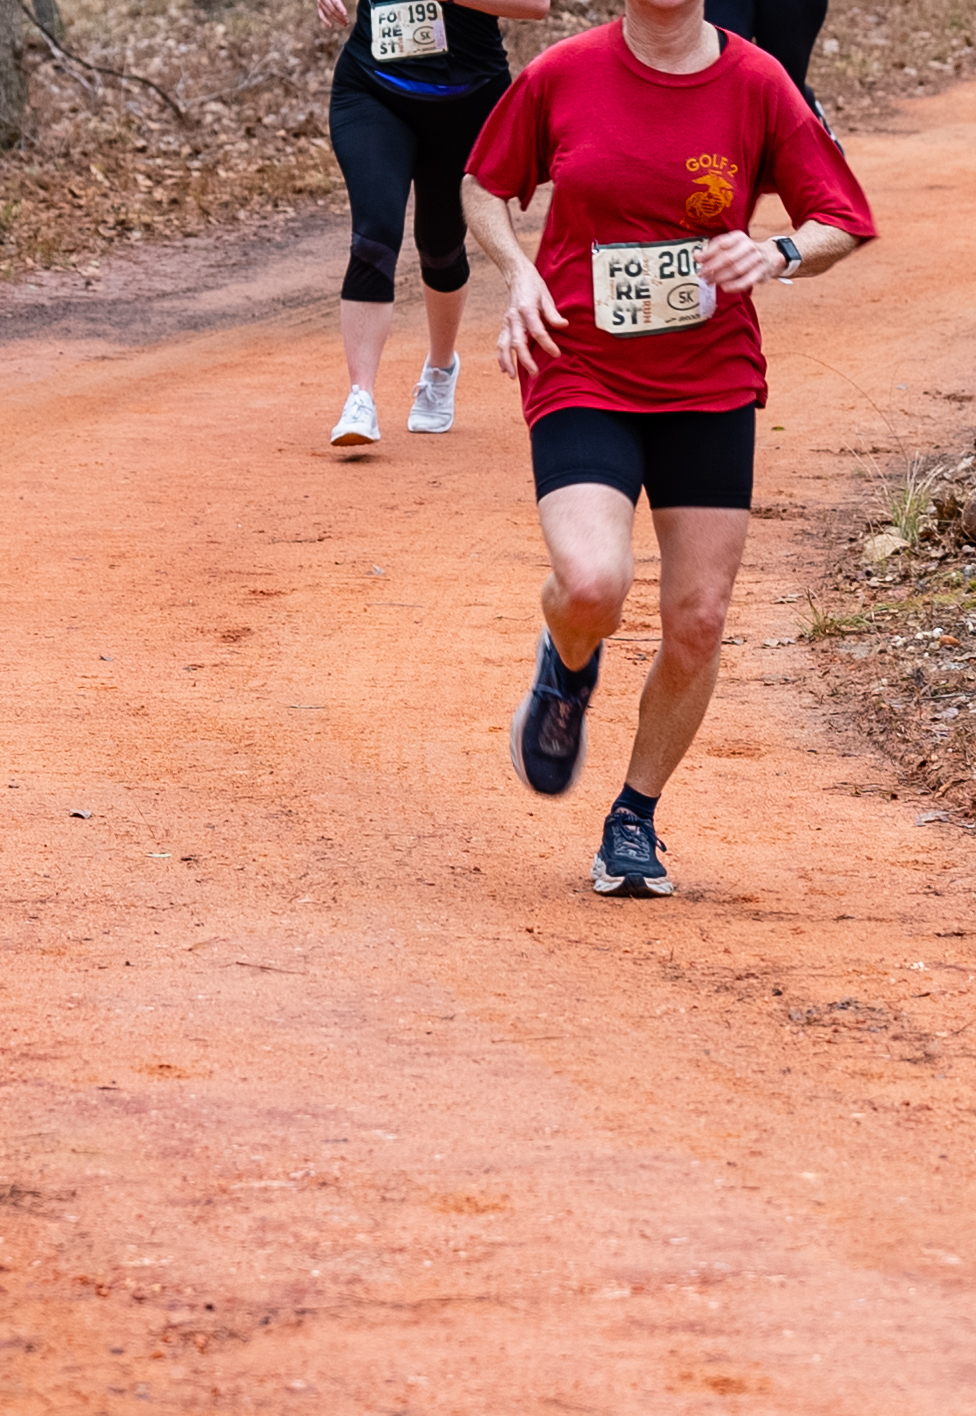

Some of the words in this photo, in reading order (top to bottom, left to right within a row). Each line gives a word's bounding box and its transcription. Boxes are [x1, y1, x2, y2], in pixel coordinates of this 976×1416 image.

[379, 12, 397, 24] FO
[408, 3, 438, 23] 199
[382, 25, 402, 38] RE
[380, 41, 397, 55] ST
[685, 153, 728, 172] GOLF
[727, 164, 739, 178] 2
[609, 260, 643, 277] FO
[616, 282, 651, 300] RE
[612, 306, 642, 326] ST
